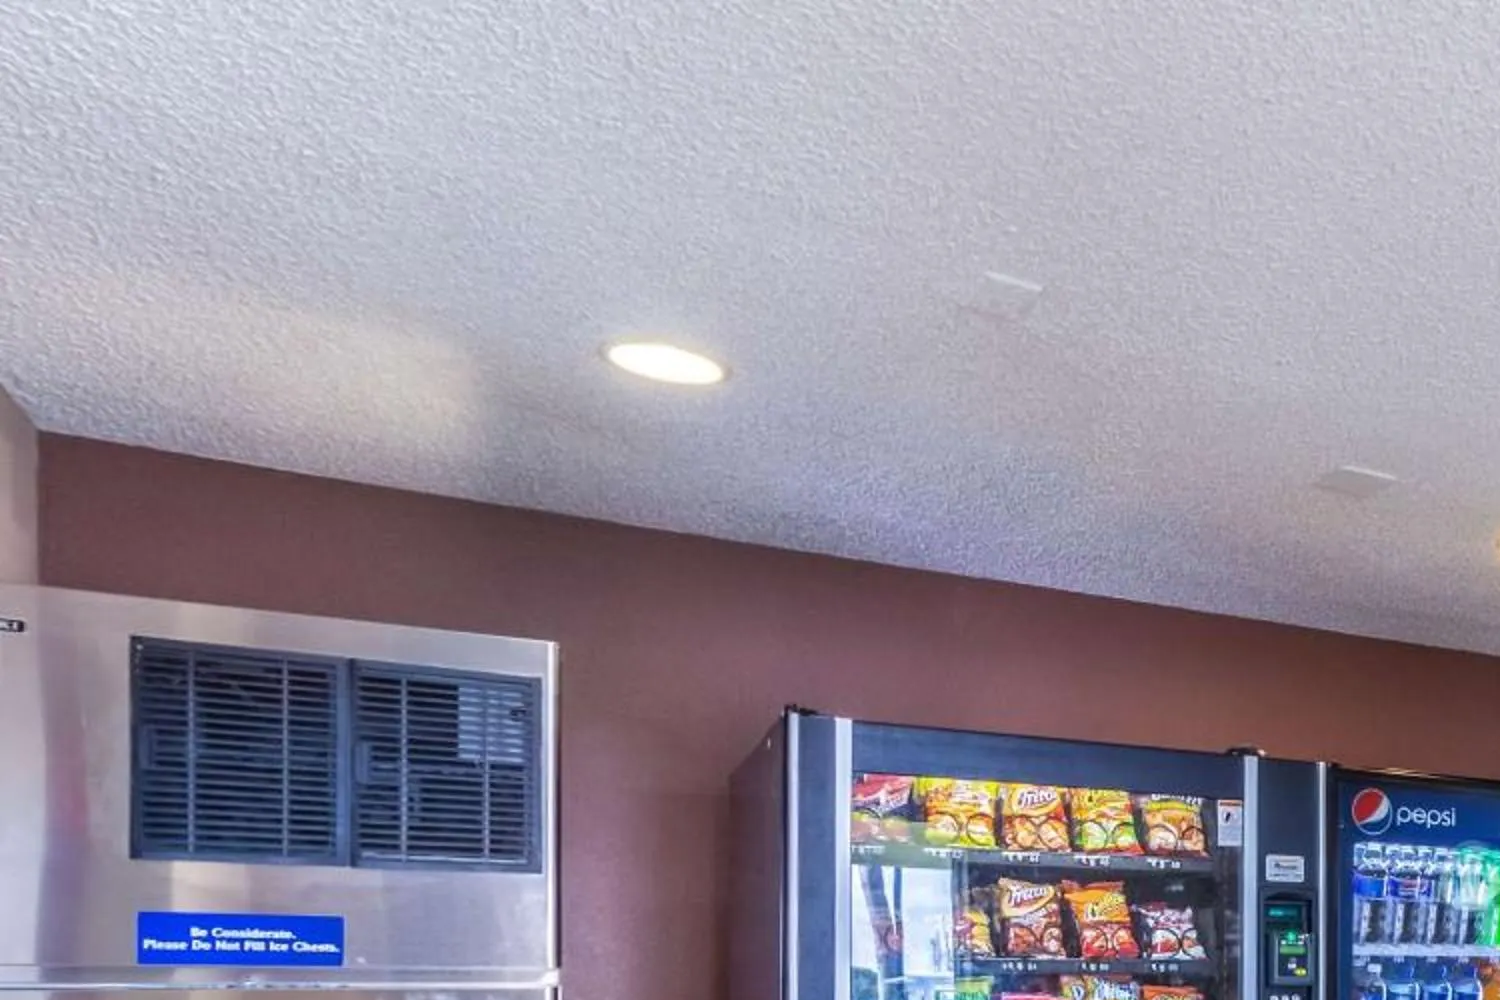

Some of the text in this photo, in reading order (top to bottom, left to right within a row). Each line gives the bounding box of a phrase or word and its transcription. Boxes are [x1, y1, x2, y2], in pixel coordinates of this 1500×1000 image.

[1396, 805, 1457, 828] pepsi
[190, 927, 297, 939] Be Considerate.
[143, 939, 341, 953] Please Do Not Fill Ice Chests.
